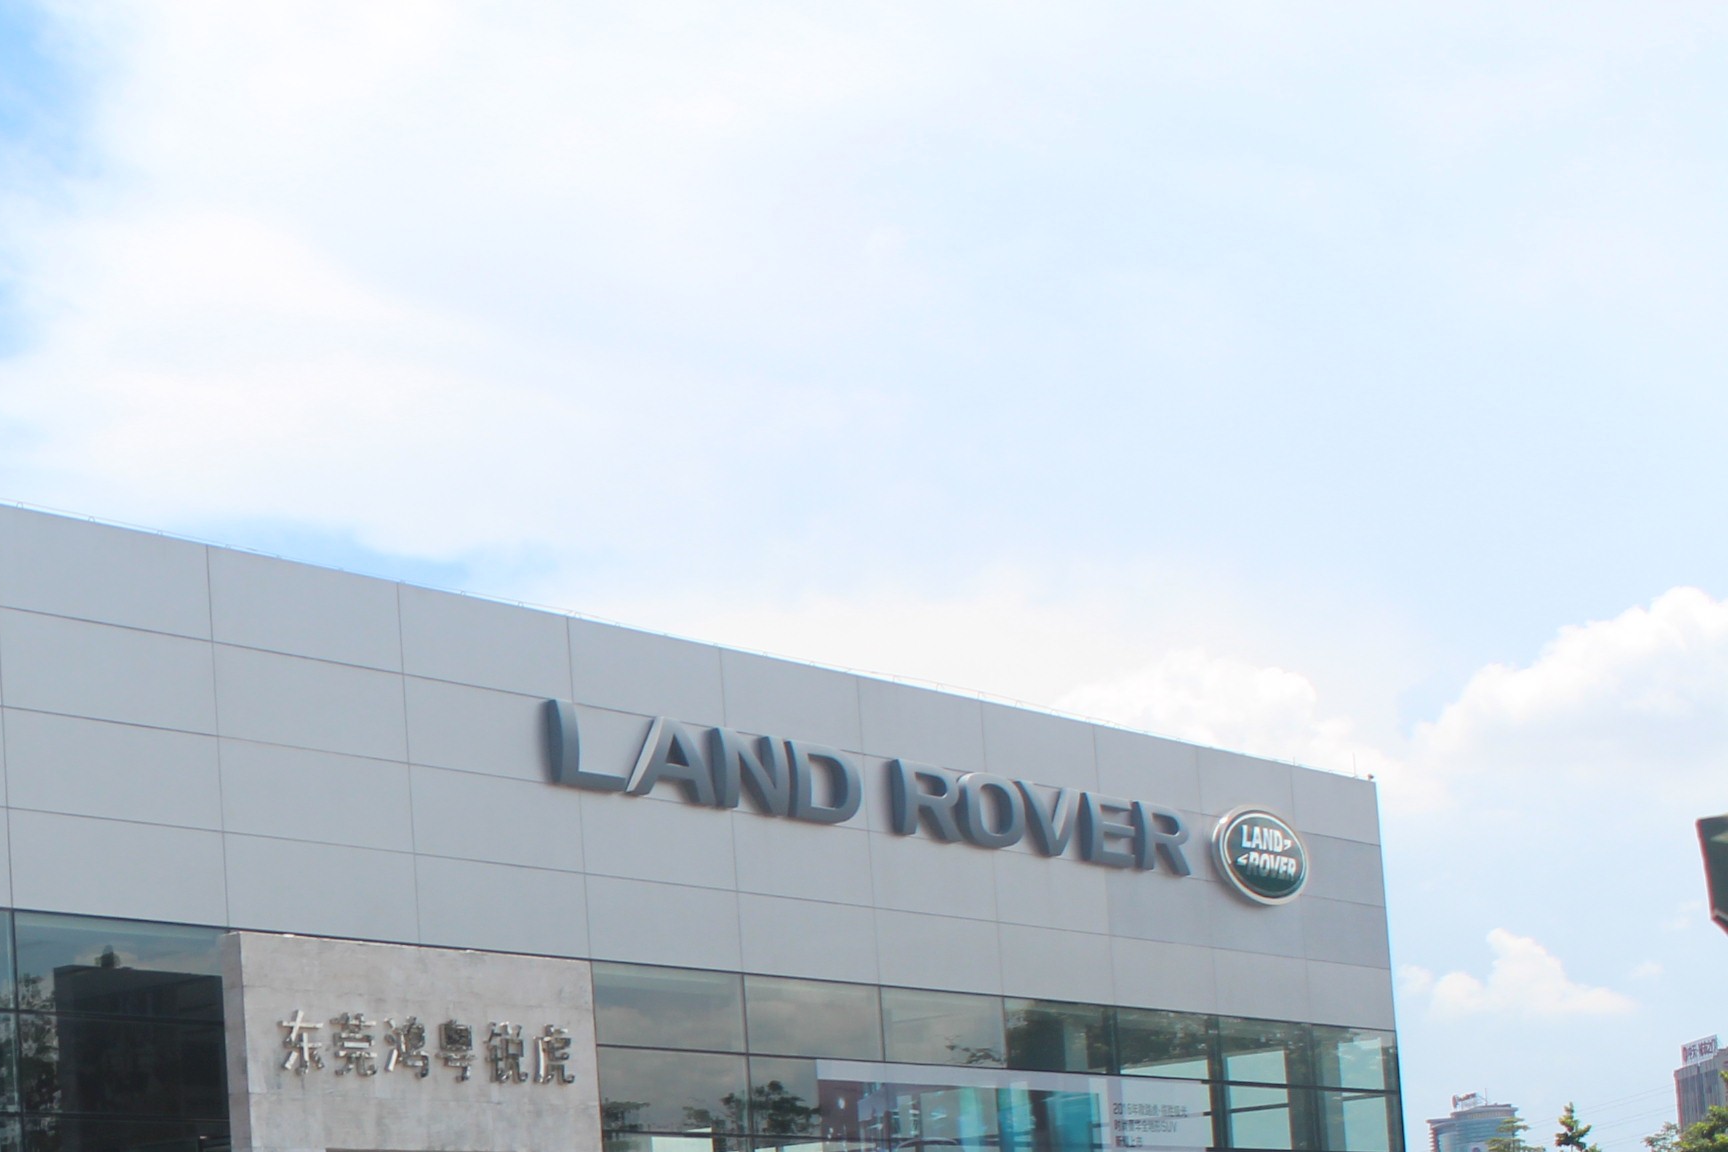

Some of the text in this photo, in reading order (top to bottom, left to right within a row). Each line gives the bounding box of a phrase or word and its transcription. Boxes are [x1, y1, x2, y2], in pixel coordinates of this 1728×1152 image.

[546, 697, 1192, 877] LAND ROVER
[1240, 824, 1284, 853] LAND
[1246, 851, 1297, 881] ROVER
